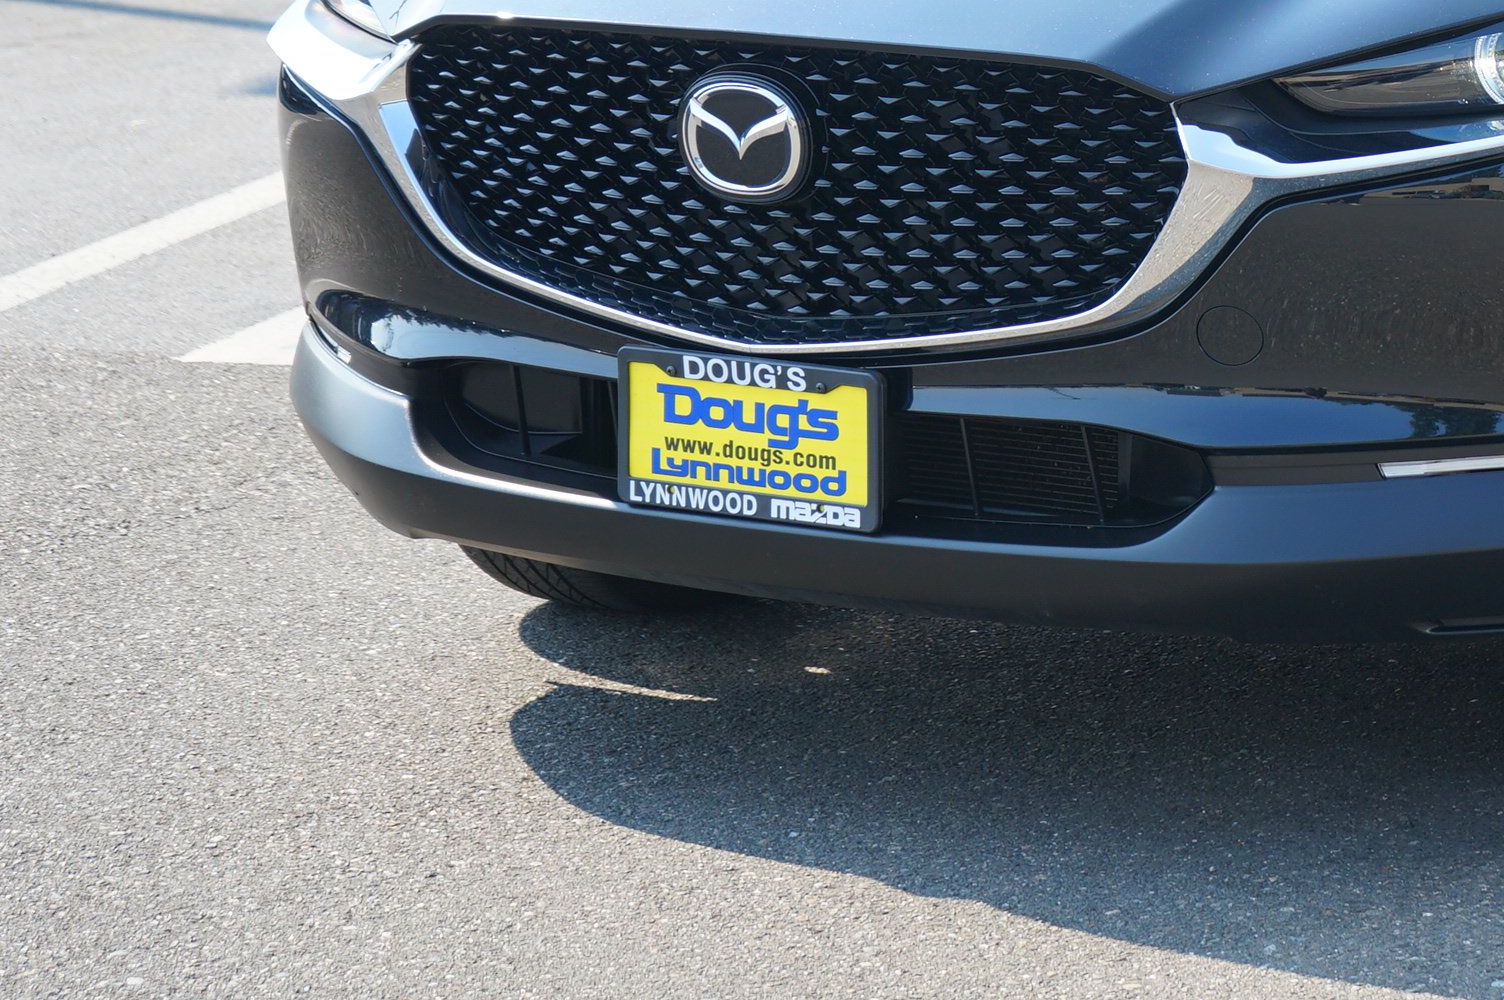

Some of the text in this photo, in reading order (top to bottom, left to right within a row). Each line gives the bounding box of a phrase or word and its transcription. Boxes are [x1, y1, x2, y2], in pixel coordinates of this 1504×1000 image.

[682, 355, 807, 392] DOUG'S
[656, 382, 840, 450] Doug's
[664, 434, 837, 471] www.dougs.com
[651, 447, 848, 497] Lynnwood
[628, 480, 758, 517] LYNNWOOD
